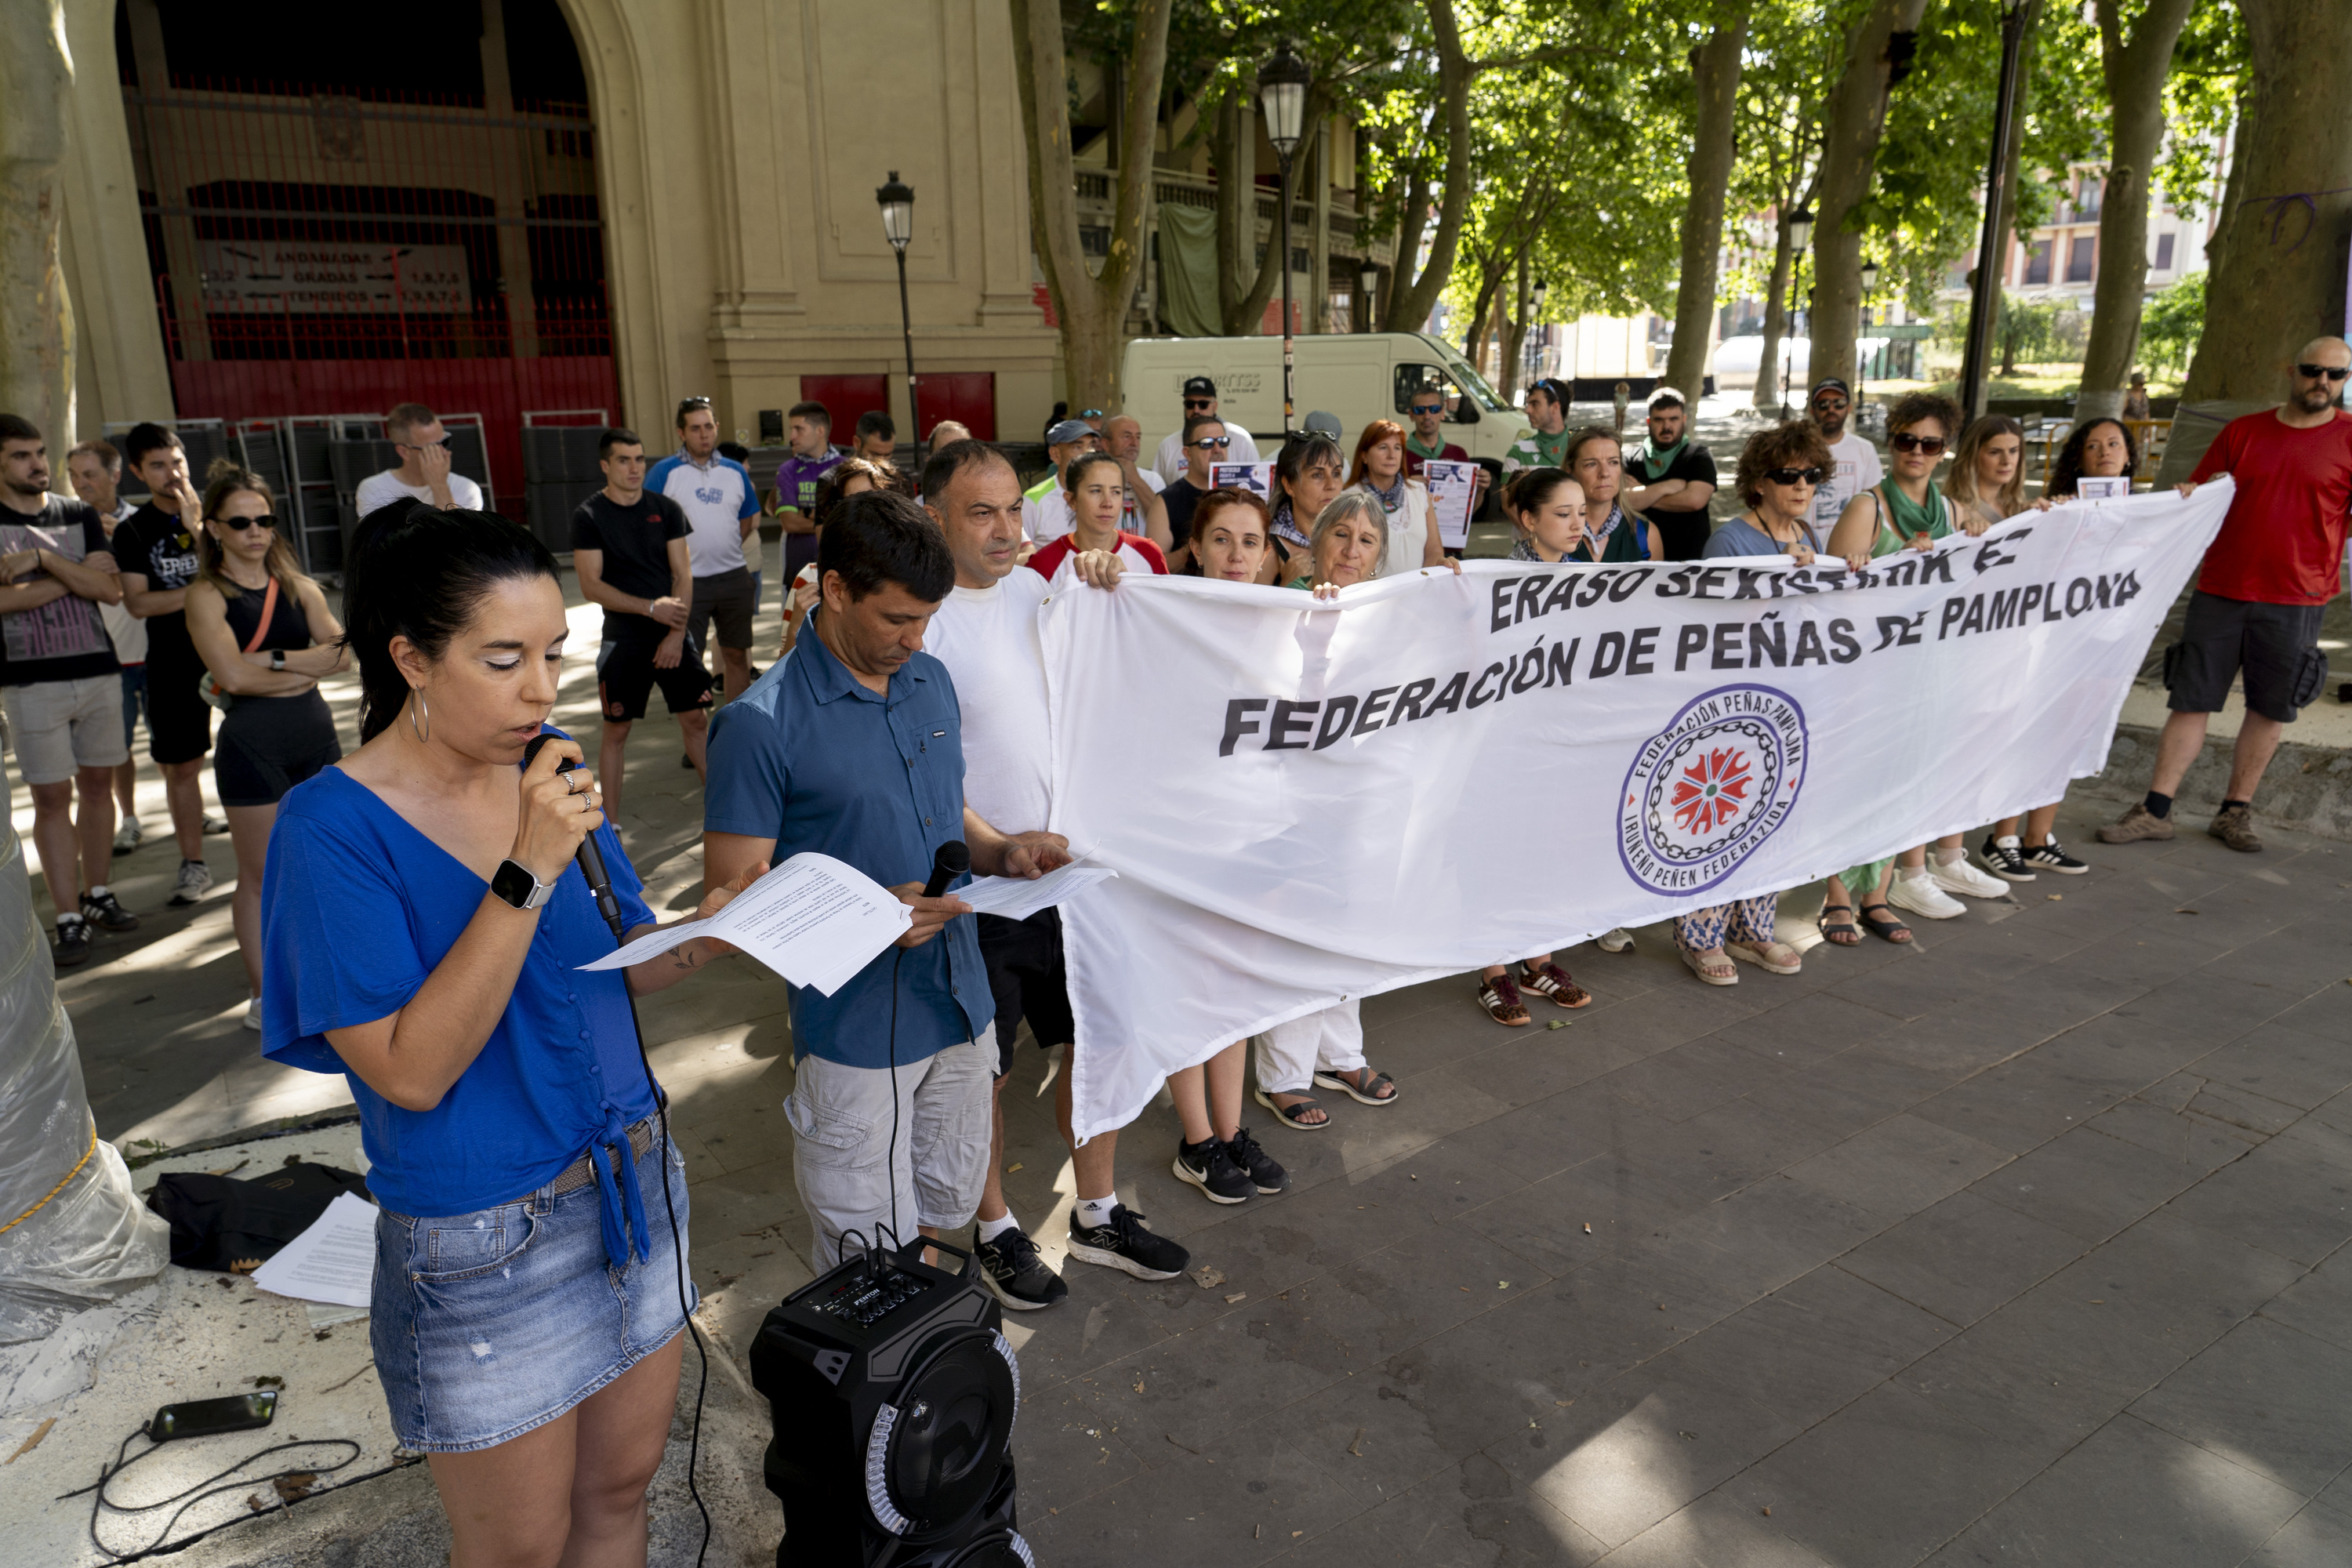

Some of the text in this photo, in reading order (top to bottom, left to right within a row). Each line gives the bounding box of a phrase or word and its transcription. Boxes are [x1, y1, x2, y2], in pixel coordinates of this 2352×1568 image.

[274, 252, 372, 264] ANDANADAS
[294, 272, 358, 283] GRADAS
[289, 291, 368, 302] TENDIDOS
[1490, 568, 1655, 633] ERASO
[1219, 568, 2142, 757] FEDERACIÓN DE PEÑAS DE PAMPLONA
[1635, 691, 1801, 779] FEDERACIÓN PEÑAS PAMPLONA
[1624, 815, 1654, 877] IRUÑEÑO
[1653, 867, 1697, 887] PEÑEN
[854, 1288, 880, 1306] FENTON
